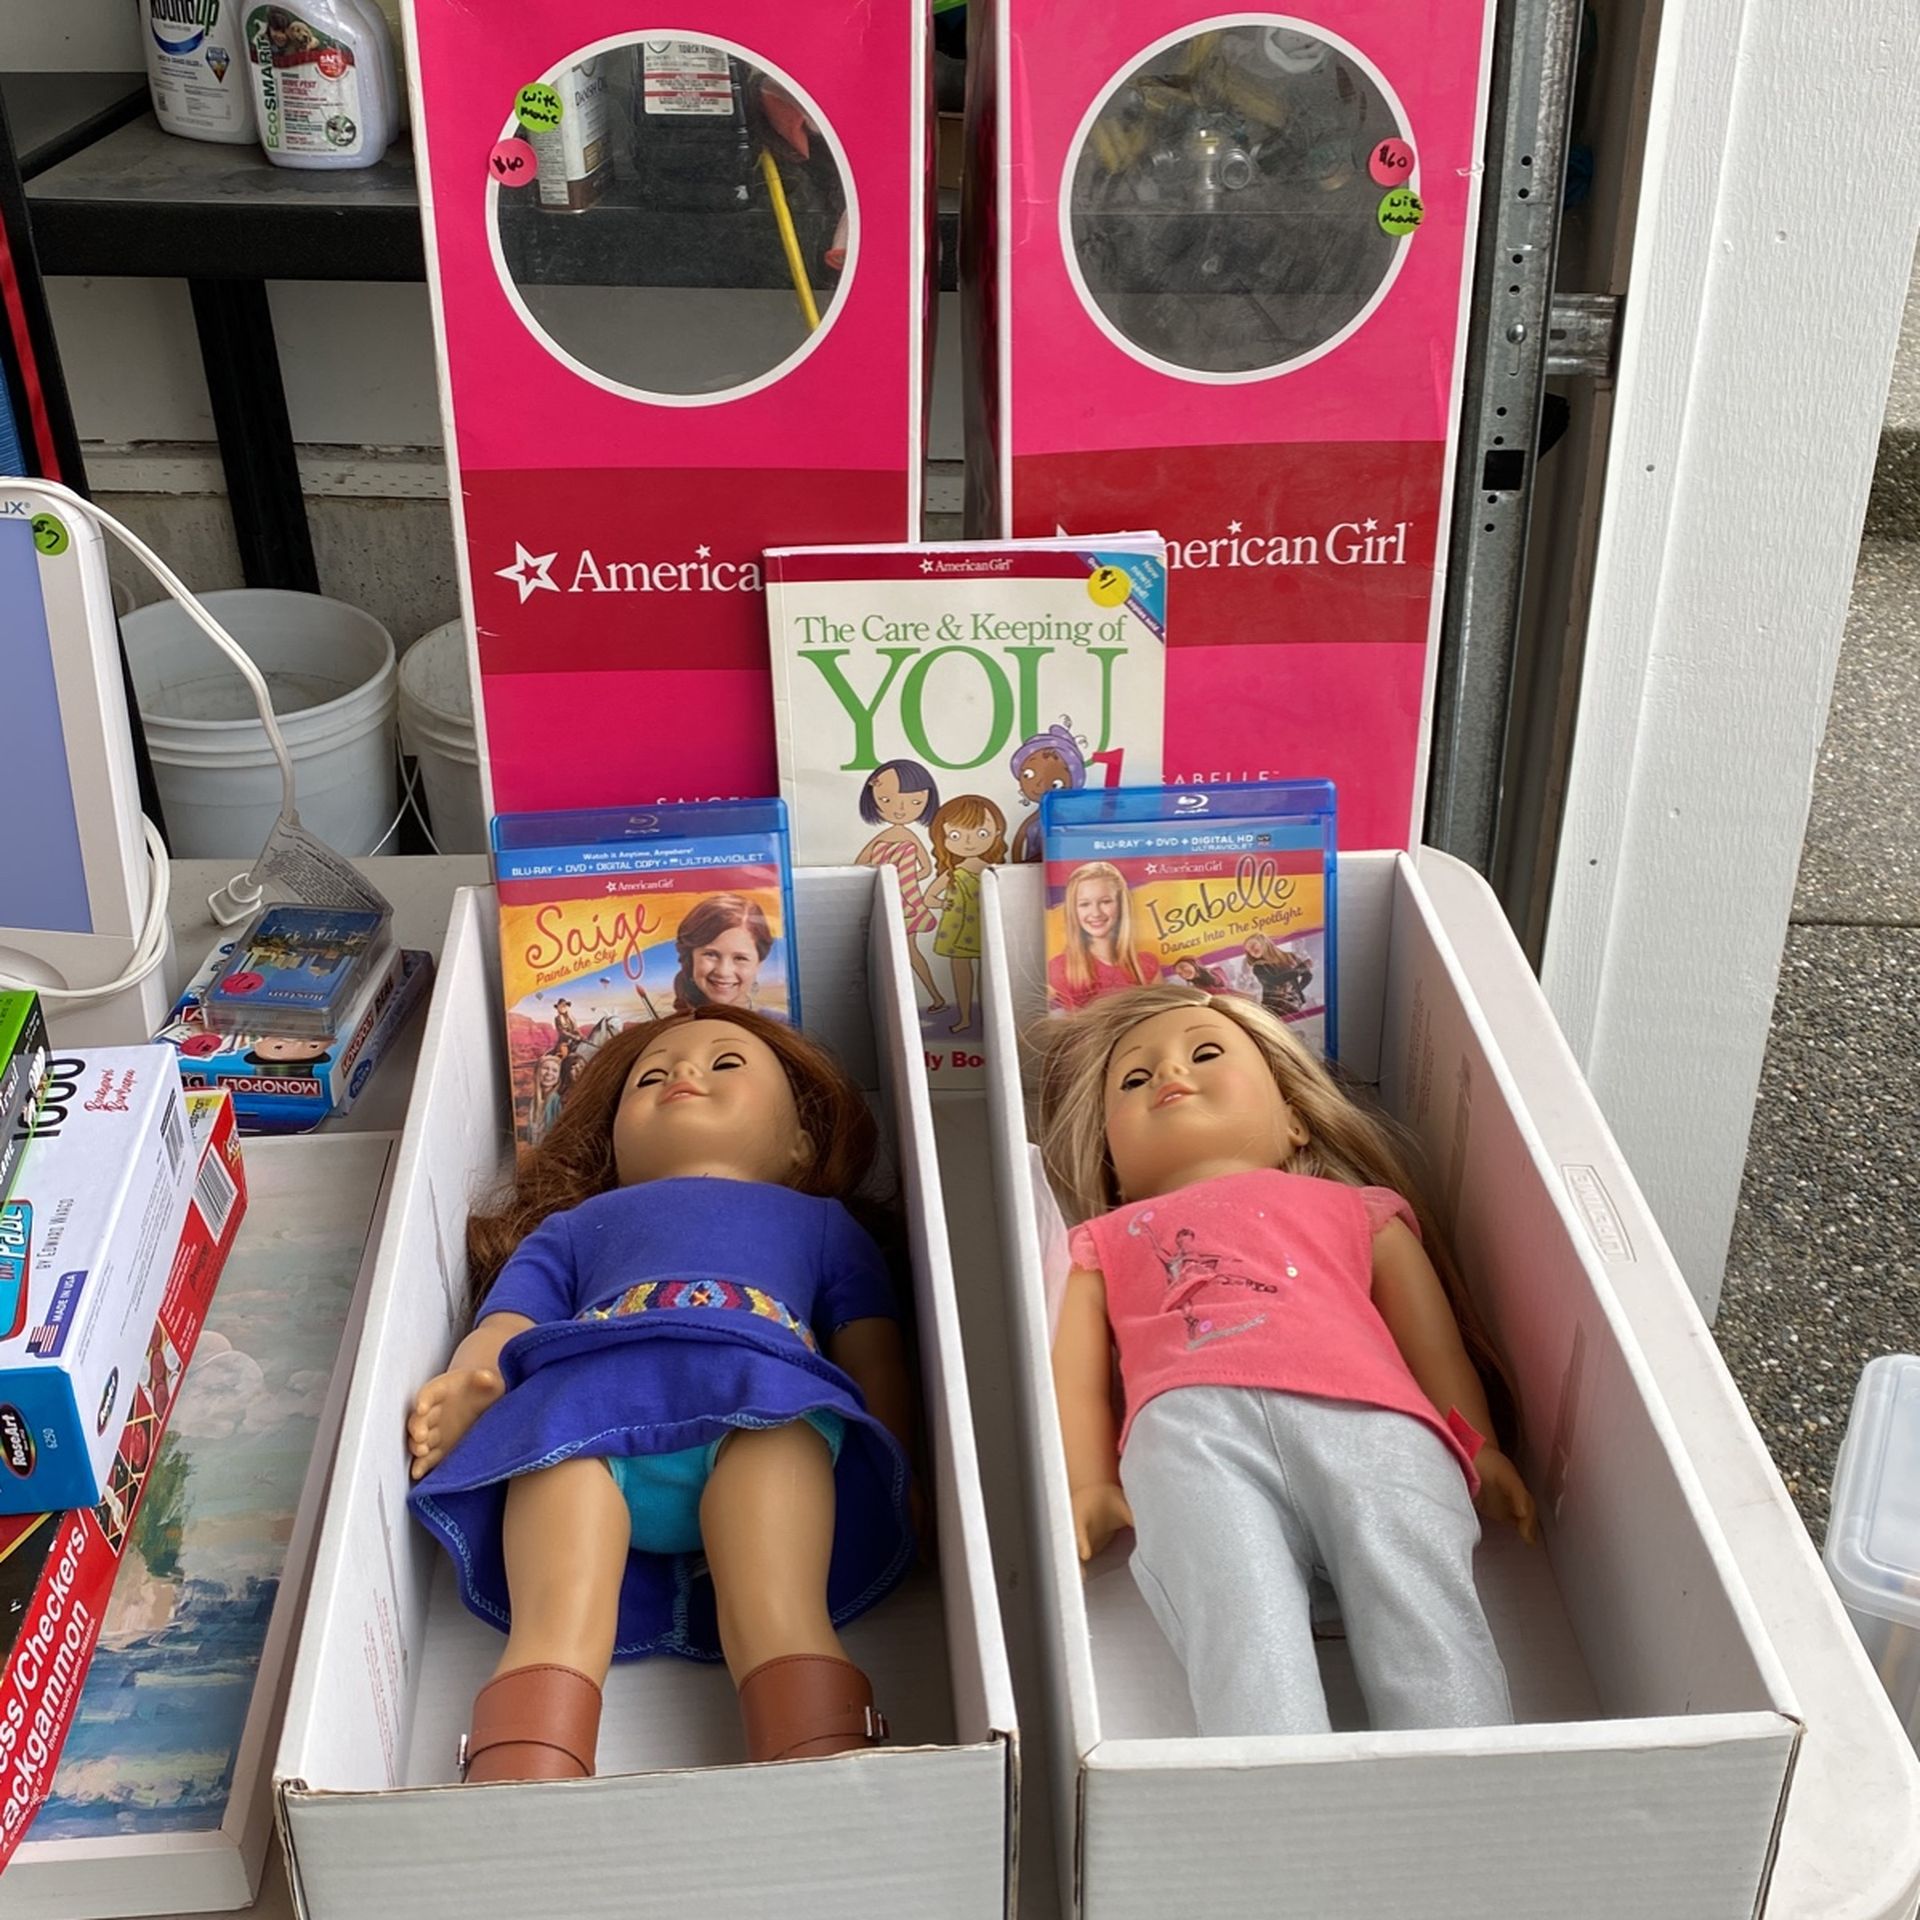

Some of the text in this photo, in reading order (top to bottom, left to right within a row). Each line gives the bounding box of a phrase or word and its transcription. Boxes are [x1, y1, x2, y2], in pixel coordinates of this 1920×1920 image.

[492, 156, 524, 174] $60
[1379, 145, 1407, 168] $60
[1165, 516, 1407, 570] merican Girl
[568, 544, 764, 593] America
[936, 558, 1010, 572] American Girl
[795, 612, 1128, 647] The Care & Keeping of
[797, 645, 1128, 771] YOU
[583, 853, 610, 861] Watch
[1156, 838, 1178, 847] DVD
[1191, 836, 1233, 845] DIGITAL
[1237, 834, 1253, 843] HD
[565, 864, 586, 873] DVD
[596, 862, 632, 871] DIGITAL
[635, 860, 660, 869] COPY
[679, 853, 765, 866] ULTRAVIOLET
[1158, 860, 1223, 874] American Girl
[617, 878, 674, 892] American Girl
[1146, 855, 1296, 940] Isabelle
[525, 904, 662, 981] Saige
[1160, 906, 1304, 955] Dances Into The Spotlight
[536, 949, 618, 985] Paints the Sky
[221, 1078, 319, 1095] MONOPOLY
[52, 1274, 77, 1323] MADE IN USA
[1, 1414, 28, 1468] RoseArt
[44, 1428, 58, 1449] 6250
[48, 1721, 61, 1751] three
[57, 1684, 74, 1721] favorite
[72, 1653, 84, 1687] game
[0, 1600, 89, 1844] ackgammon
